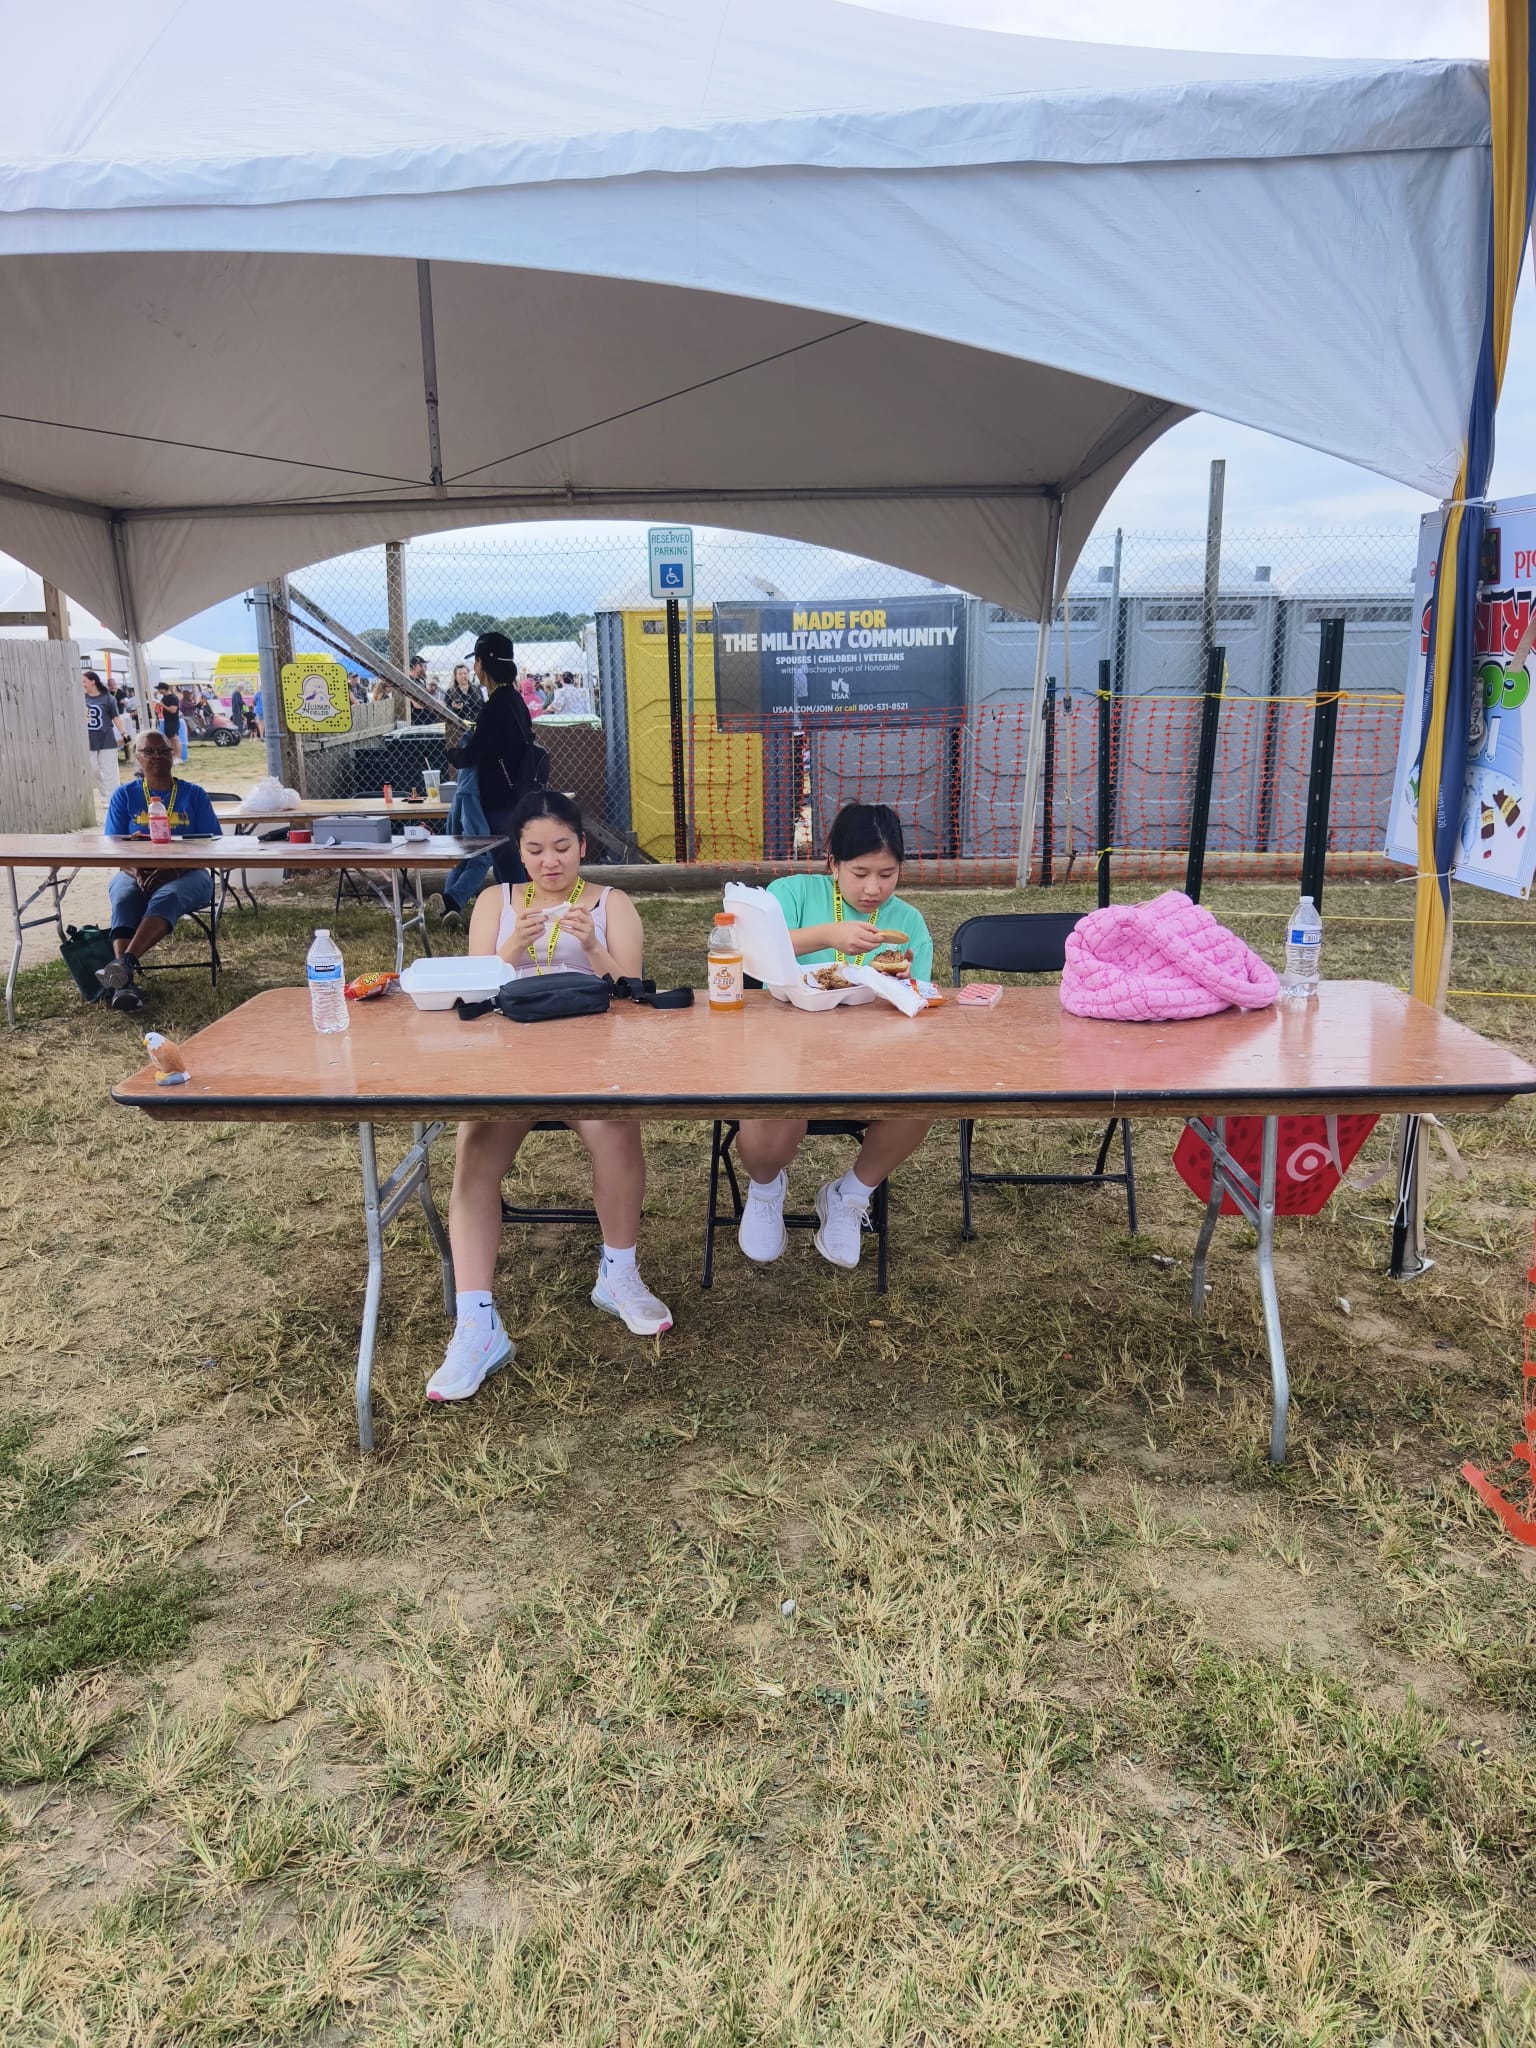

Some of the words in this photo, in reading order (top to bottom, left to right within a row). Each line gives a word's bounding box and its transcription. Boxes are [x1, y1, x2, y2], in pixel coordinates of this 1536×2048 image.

[651, 534, 690, 544] RESERVED
[654, 546, 688, 556] PARKING
[792, 610, 846, 631] MADE
[849, 609, 887, 629] FOR
[722, 633, 758, 652] THE
[761, 630, 844, 652] MILITARY
[847, 626, 958, 649] COMMUNITY
[775, 655, 811, 665] SPOUSES
[818, 654, 857, 664] CHILDREN
[863, 653, 905, 662] VETERANS
[803, 665, 837, 675] discharge
[838, 665, 854, 674] type
[855, 664, 863, 672] of
[864, 663, 900, 672] Honorable
[831, 692, 849, 700] USAA
[302, 702, 331, 714] HUDSON
[772, 704, 833, 713] USAA.COM/JOIN
[859, 702, 909, 711] 800-531-8521
[712, 976, 736, 985] ZERO
